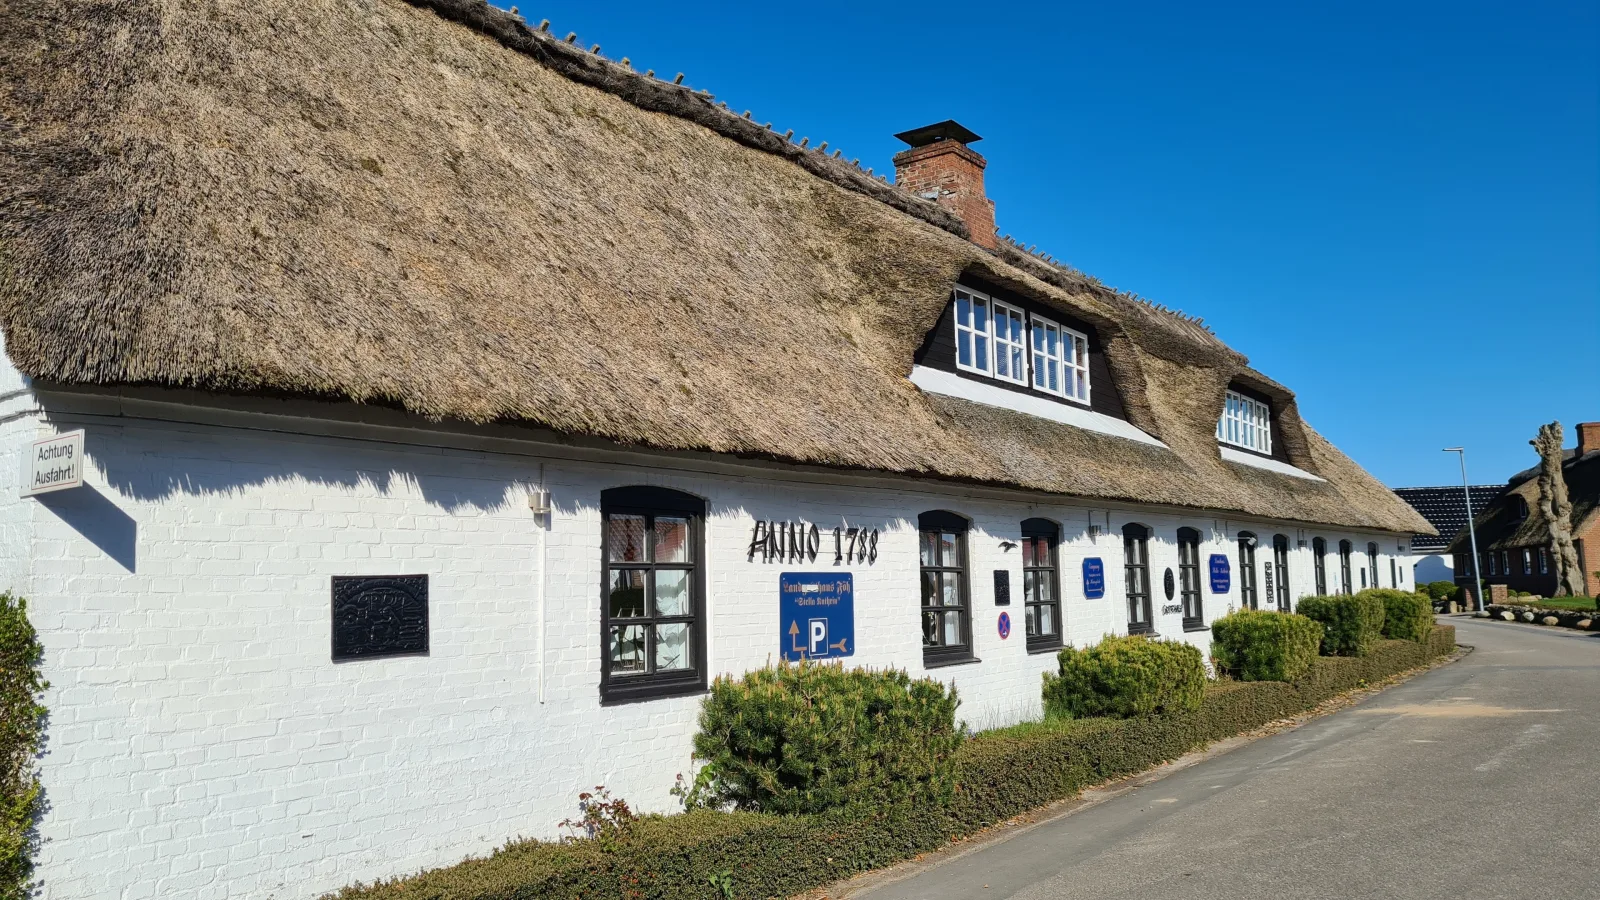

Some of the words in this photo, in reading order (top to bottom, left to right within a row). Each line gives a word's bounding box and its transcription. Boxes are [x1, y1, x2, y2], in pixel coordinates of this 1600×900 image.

[38, 444, 73, 462] Achtung
[35, 463, 75, 486] Ausfahrt!
[748, 520, 820, 560] ANNO
[833, 526, 879, 562] 1788
[783, 581, 835, 596] Landhaus
[810, 621, 826, 653] P
